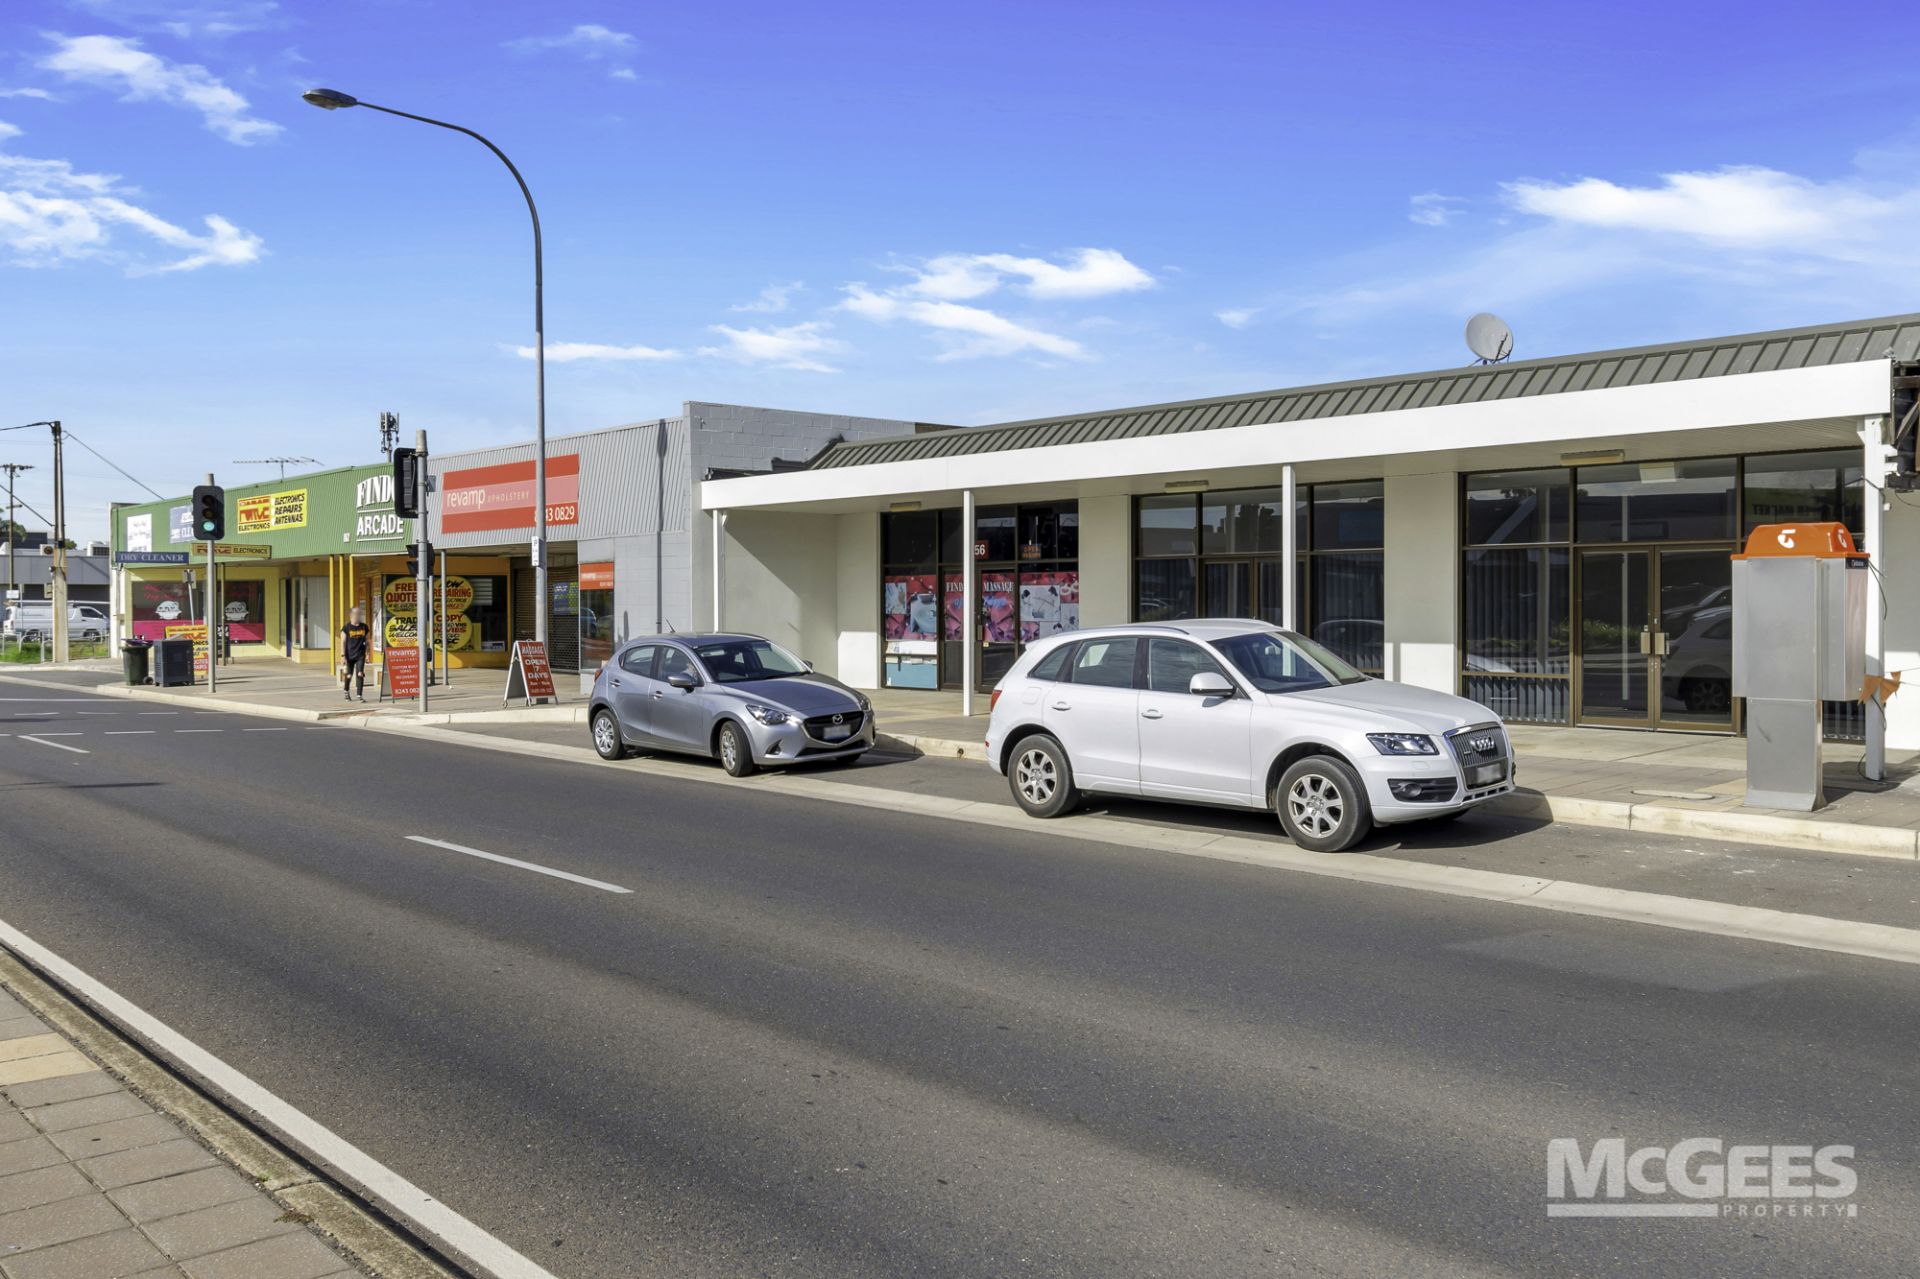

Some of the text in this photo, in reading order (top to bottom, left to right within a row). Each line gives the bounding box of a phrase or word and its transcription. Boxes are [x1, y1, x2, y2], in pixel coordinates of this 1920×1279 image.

[356, 475, 395, 509] FIND
[274, 493, 305, 506] ELECTRONICS
[446, 489, 530, 509] revamp UPHOLSTERY
[274, 504, 303, 515] REPAIRS
[555, 506, 575, 521] 0829
[274, 514, 303, 526] ANTENNAS
[356, 514, 404, 536] ARCADE
[238, 523, 271, 532] ELECTRONICS
[233, 547, 268, 555] ELECTRONICS
[120, 553, 184, 562] DRY CLEANER
[946, 581, 1014, 593] FIND MASSAGE
[386, 592, 418, 603] QUOTE
[434, 588, 472, 598] REAIRING
[395, 617, 418, 625] TRAD
[388, 649, 417, 657] revamp
